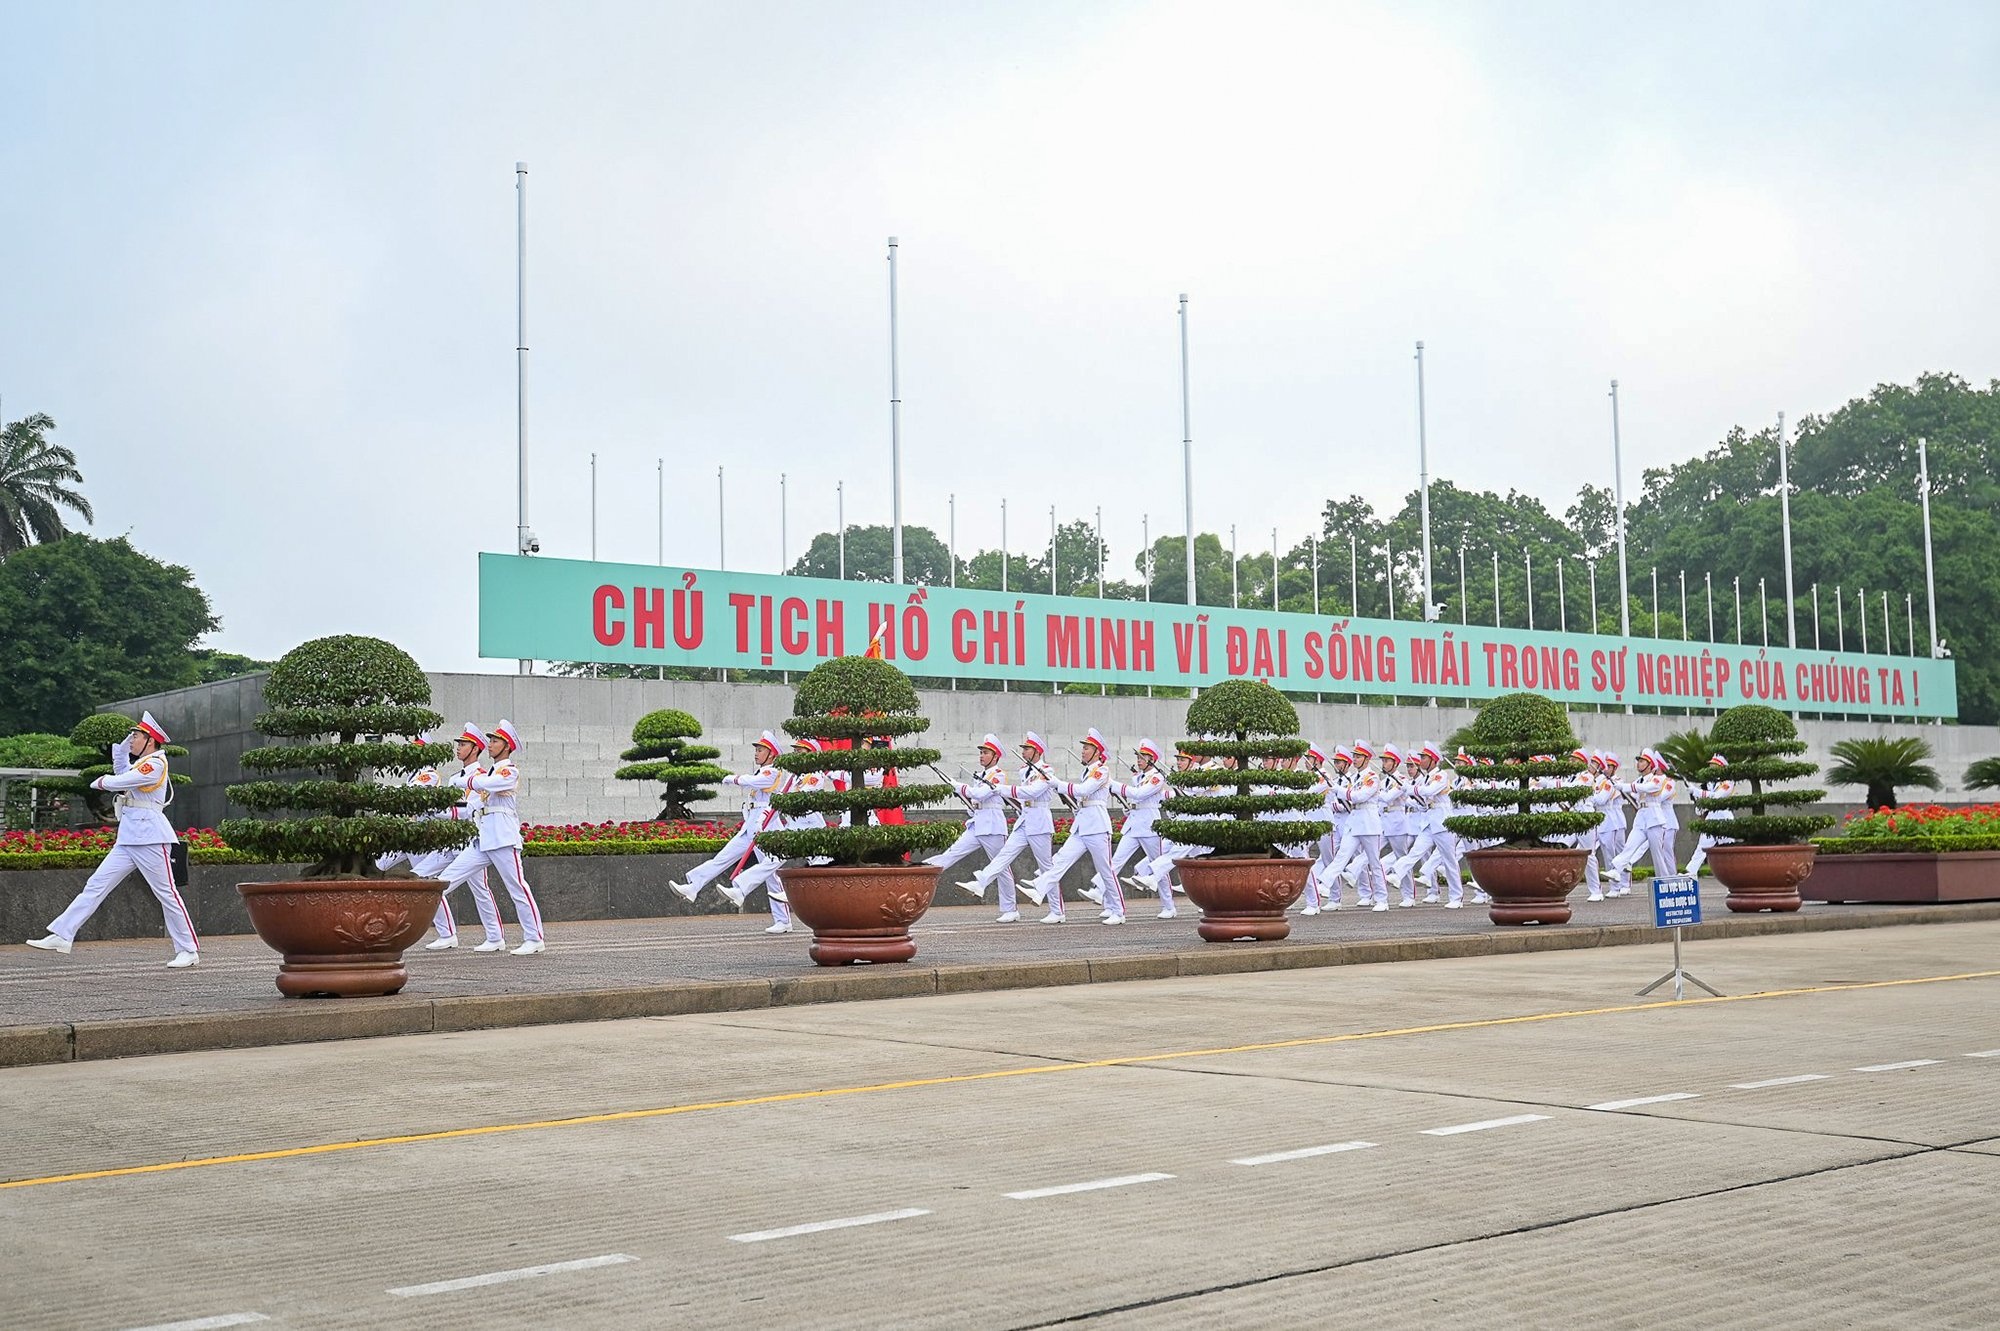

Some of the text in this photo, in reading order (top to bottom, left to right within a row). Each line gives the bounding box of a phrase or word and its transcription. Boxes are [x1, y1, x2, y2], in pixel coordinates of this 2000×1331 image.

[592, 572, 704, 650] CHỦ
[729, 594, 844, 666] TỊCH
[868, 587, 929, 661] HỒ
[952, 600, 1026, 666] CHÍ
[1046, 614, 1155, 672] MINH
[1173, 615, 1209, 675] VĨ
[1226, 626, 1288, 684] ĐẠI
[1304, 619, 1396, 682] SỐNG
[1411, 631, 1471, 686] MÃI
[1483, 641, 1580, 691] TRONG
[1591, 645, 1628, 701] SỰ
[1637, 648, 1731, 705] NGHIỆP
[1740, 648, 1788, 702] CỦA
[1796, 656, 1871, 705] CHÚNG
[1878, 668, 1905, 706] TA
